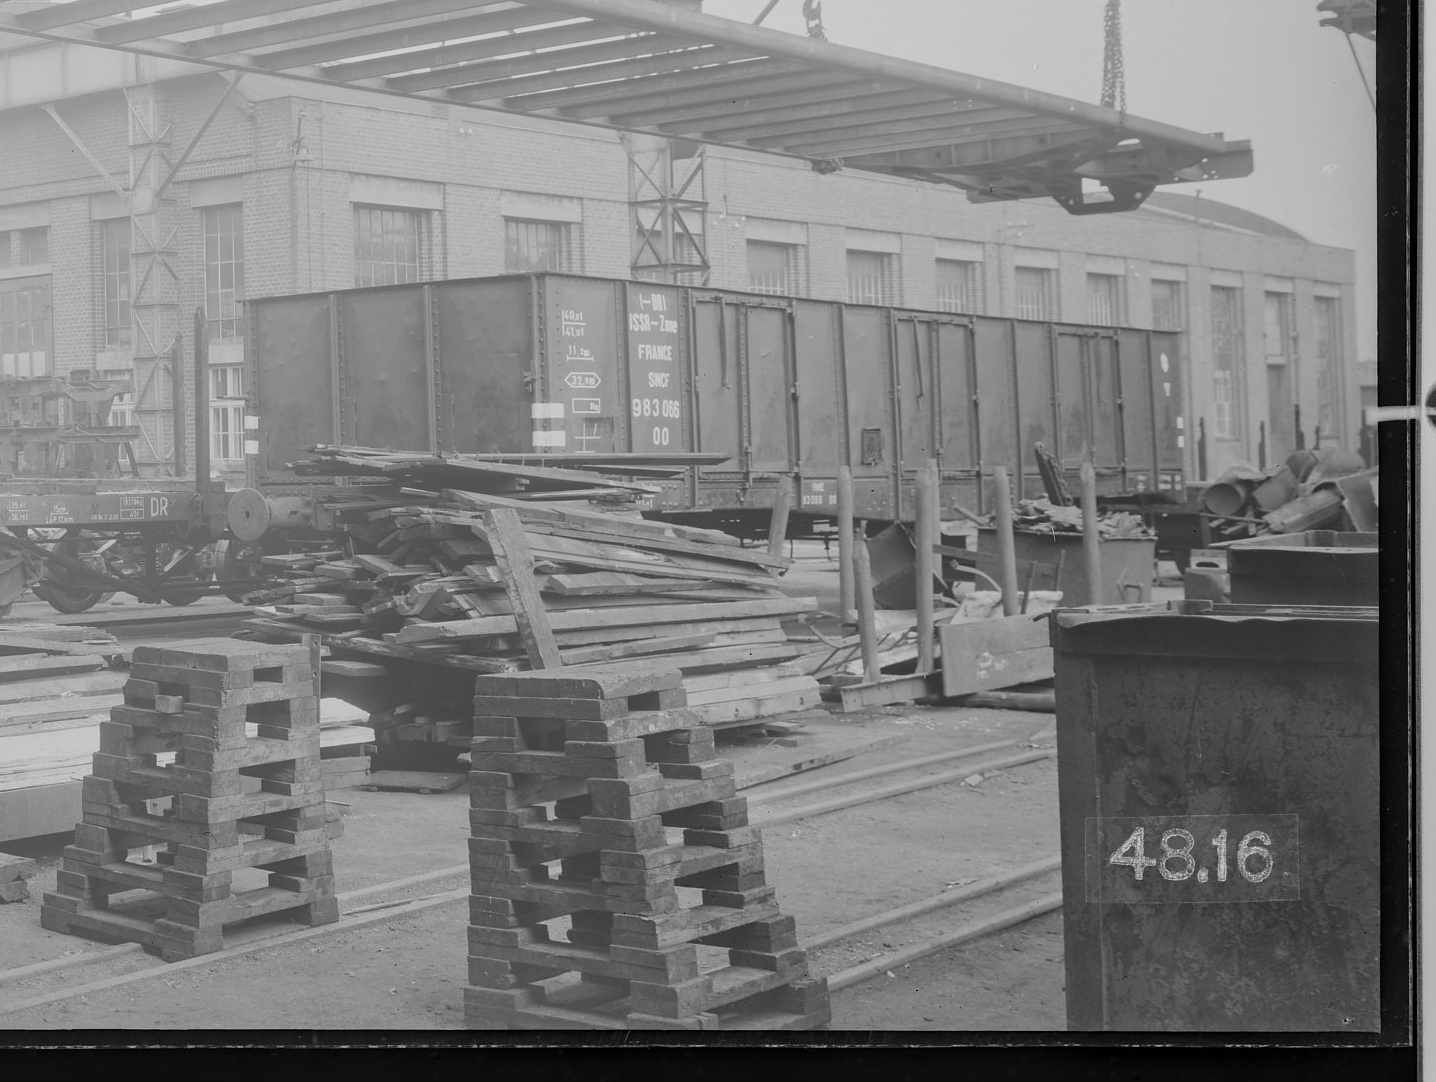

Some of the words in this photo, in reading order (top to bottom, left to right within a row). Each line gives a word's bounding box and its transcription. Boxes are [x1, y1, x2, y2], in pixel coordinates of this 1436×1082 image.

[638, 344, 673, 361] FRANCE
[648, 372, 670, 388] SNCF
[632, 398, 659, 417] 983
[653, 426, 669, 445] 00
[150, 497, 168, 517] DR
